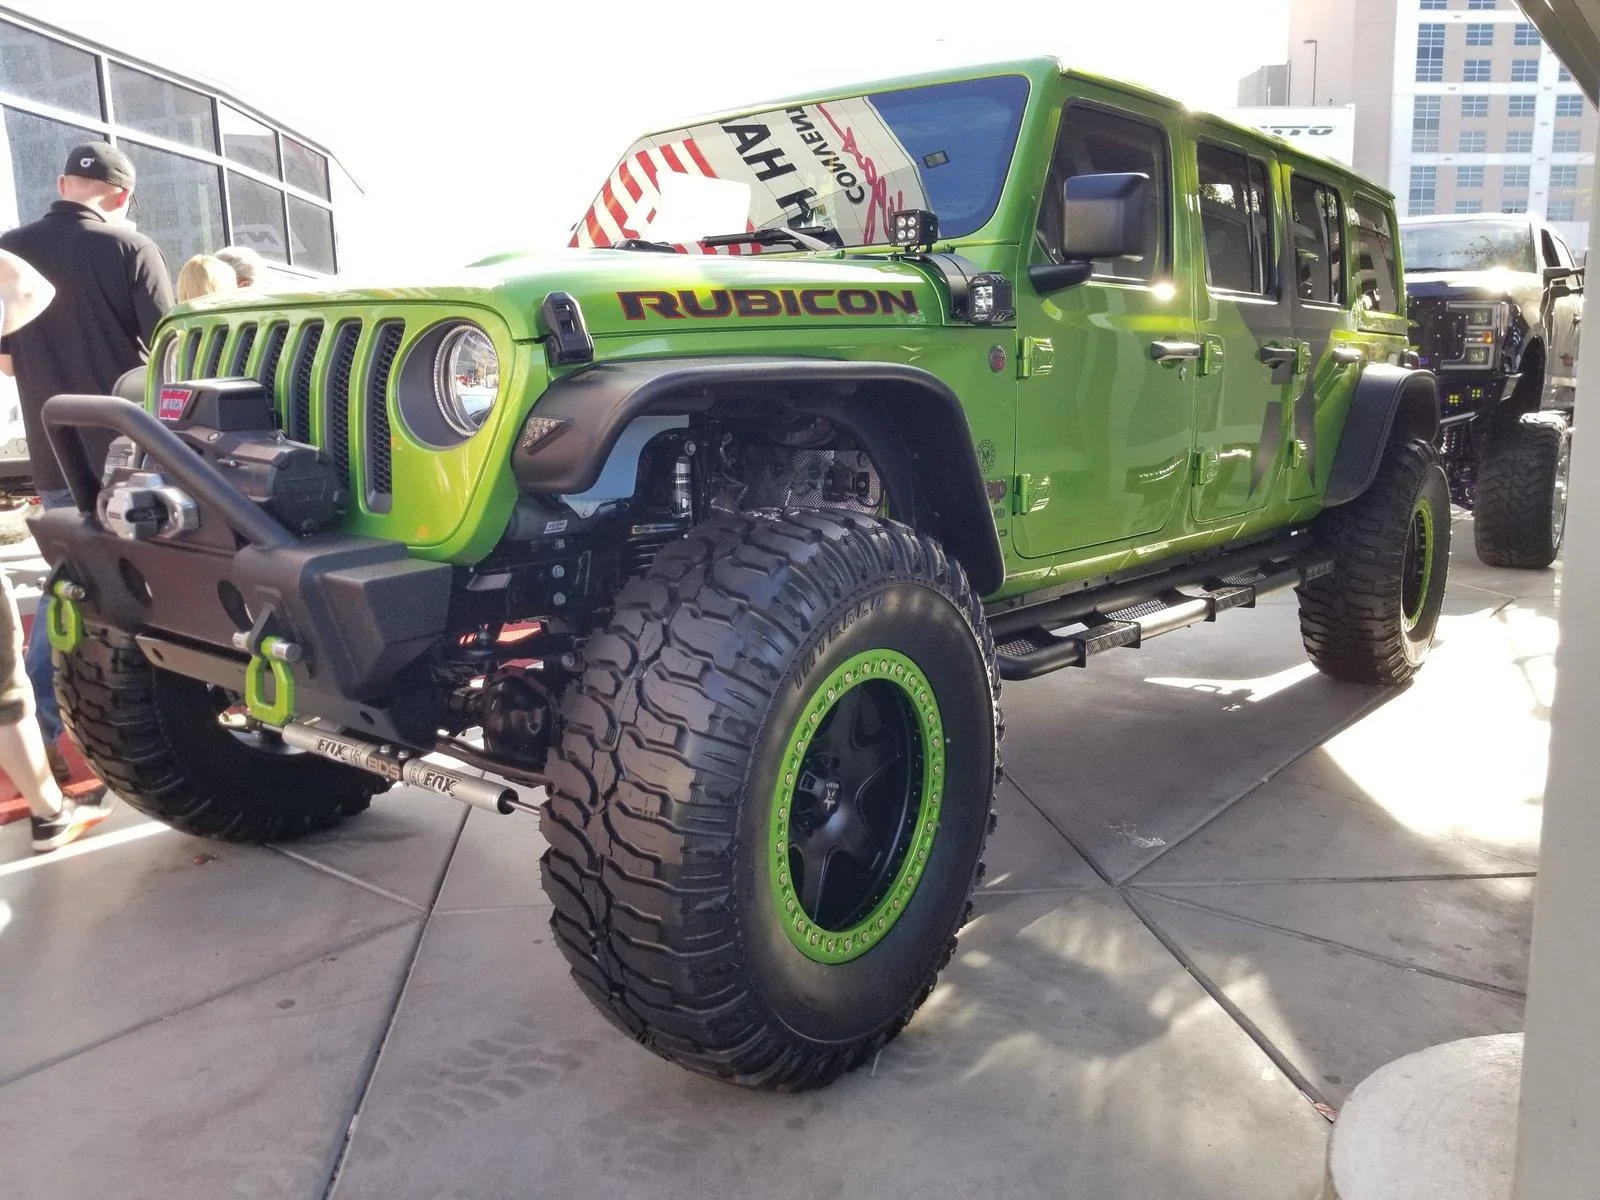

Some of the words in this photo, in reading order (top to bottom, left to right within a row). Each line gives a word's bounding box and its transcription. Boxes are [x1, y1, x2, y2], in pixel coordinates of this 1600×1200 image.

[616, 288, 919, 321] RUBICON
[315, 736, 354, 761] FOX
[367, 756, 400, 780] BDS
[422, 770, 462, 799] FOX
